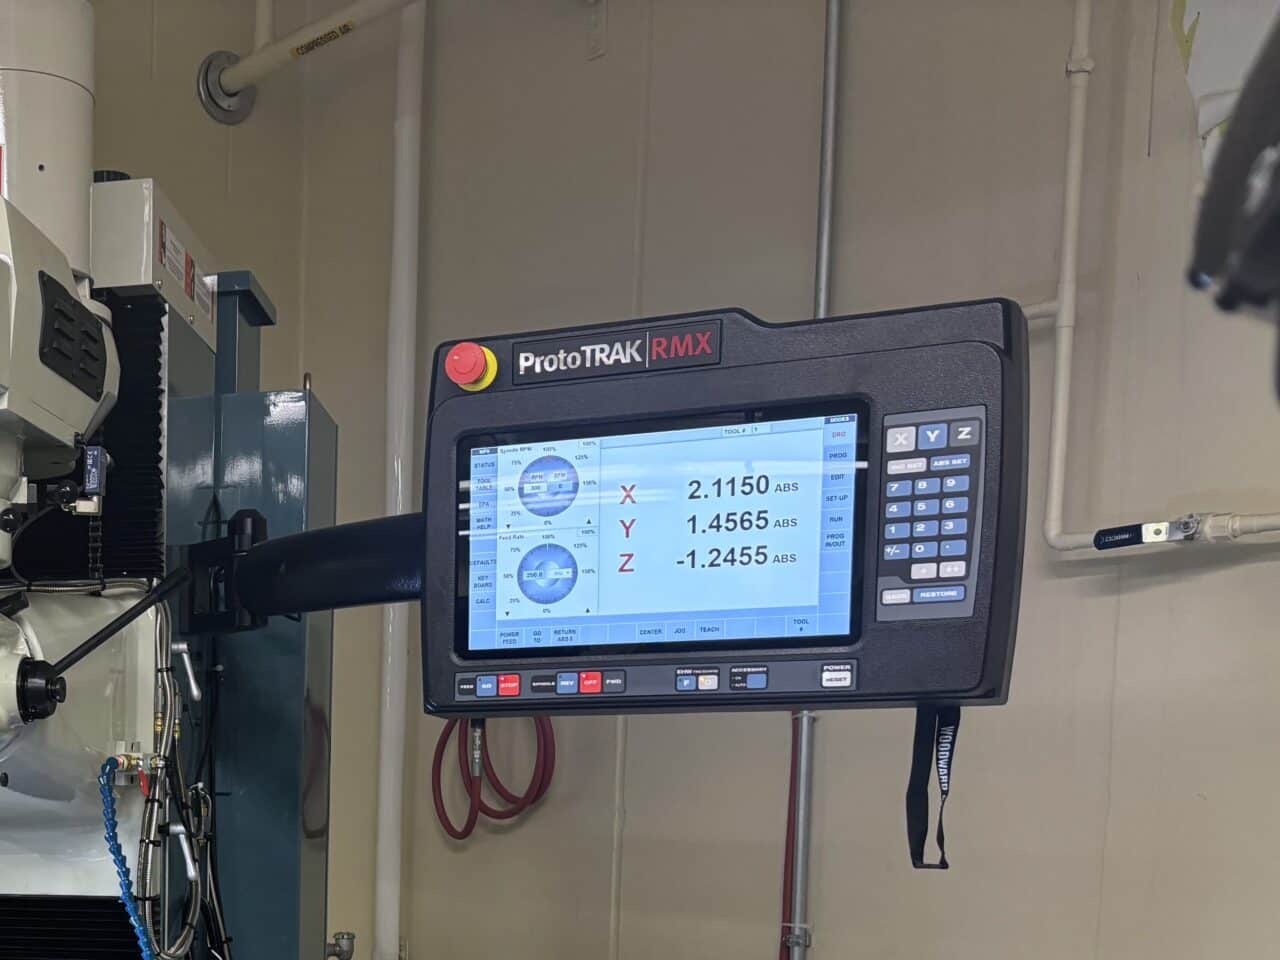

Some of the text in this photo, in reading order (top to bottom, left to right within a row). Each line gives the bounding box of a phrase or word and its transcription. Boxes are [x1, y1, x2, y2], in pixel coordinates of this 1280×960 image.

[519, 331, 713, 375] ProtoTRAK RMX
[894, 426, 972, 446] X Y Z
[619, 474, 800, 505] X 2.1150 ABS
[889, 483, 899, 491] 7
[946, 479, 956, 487] 9
[888, 500, 955, 512] 4 5 6
[619, 509, 798, 538] Y 1.4565 ABS
[889, 521, 954, 534] 1 2 3
[915, 544, 925, 553] 0
[618, 545, 797, 573] Z -1.2455 ABS
[639, 628, 663, 636] CENTER
[937, 725, 956, 791] WOODWARD
